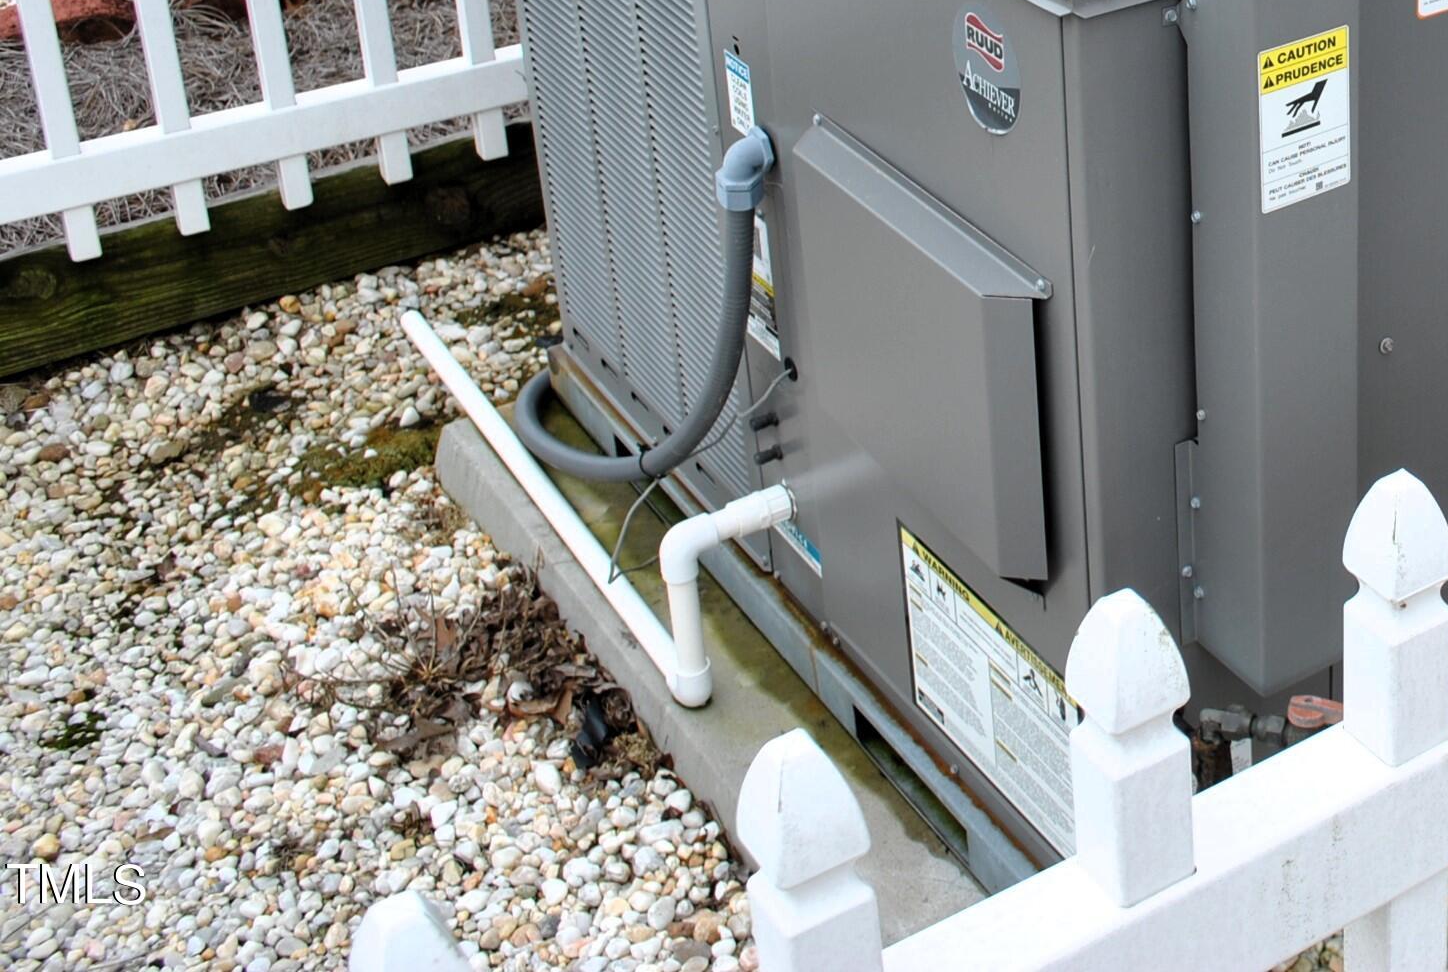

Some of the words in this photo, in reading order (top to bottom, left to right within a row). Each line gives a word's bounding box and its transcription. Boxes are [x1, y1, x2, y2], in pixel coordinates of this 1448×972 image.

[967, 25, 1003, 60] RUUD
[1276, 36, 1336, 64] CAUTION
[1275, 54, 1344, 85] PRUDENCE
[963, 59, 1015, 117] ACHIEVER
[921, 550, 970, 602] WARNING
